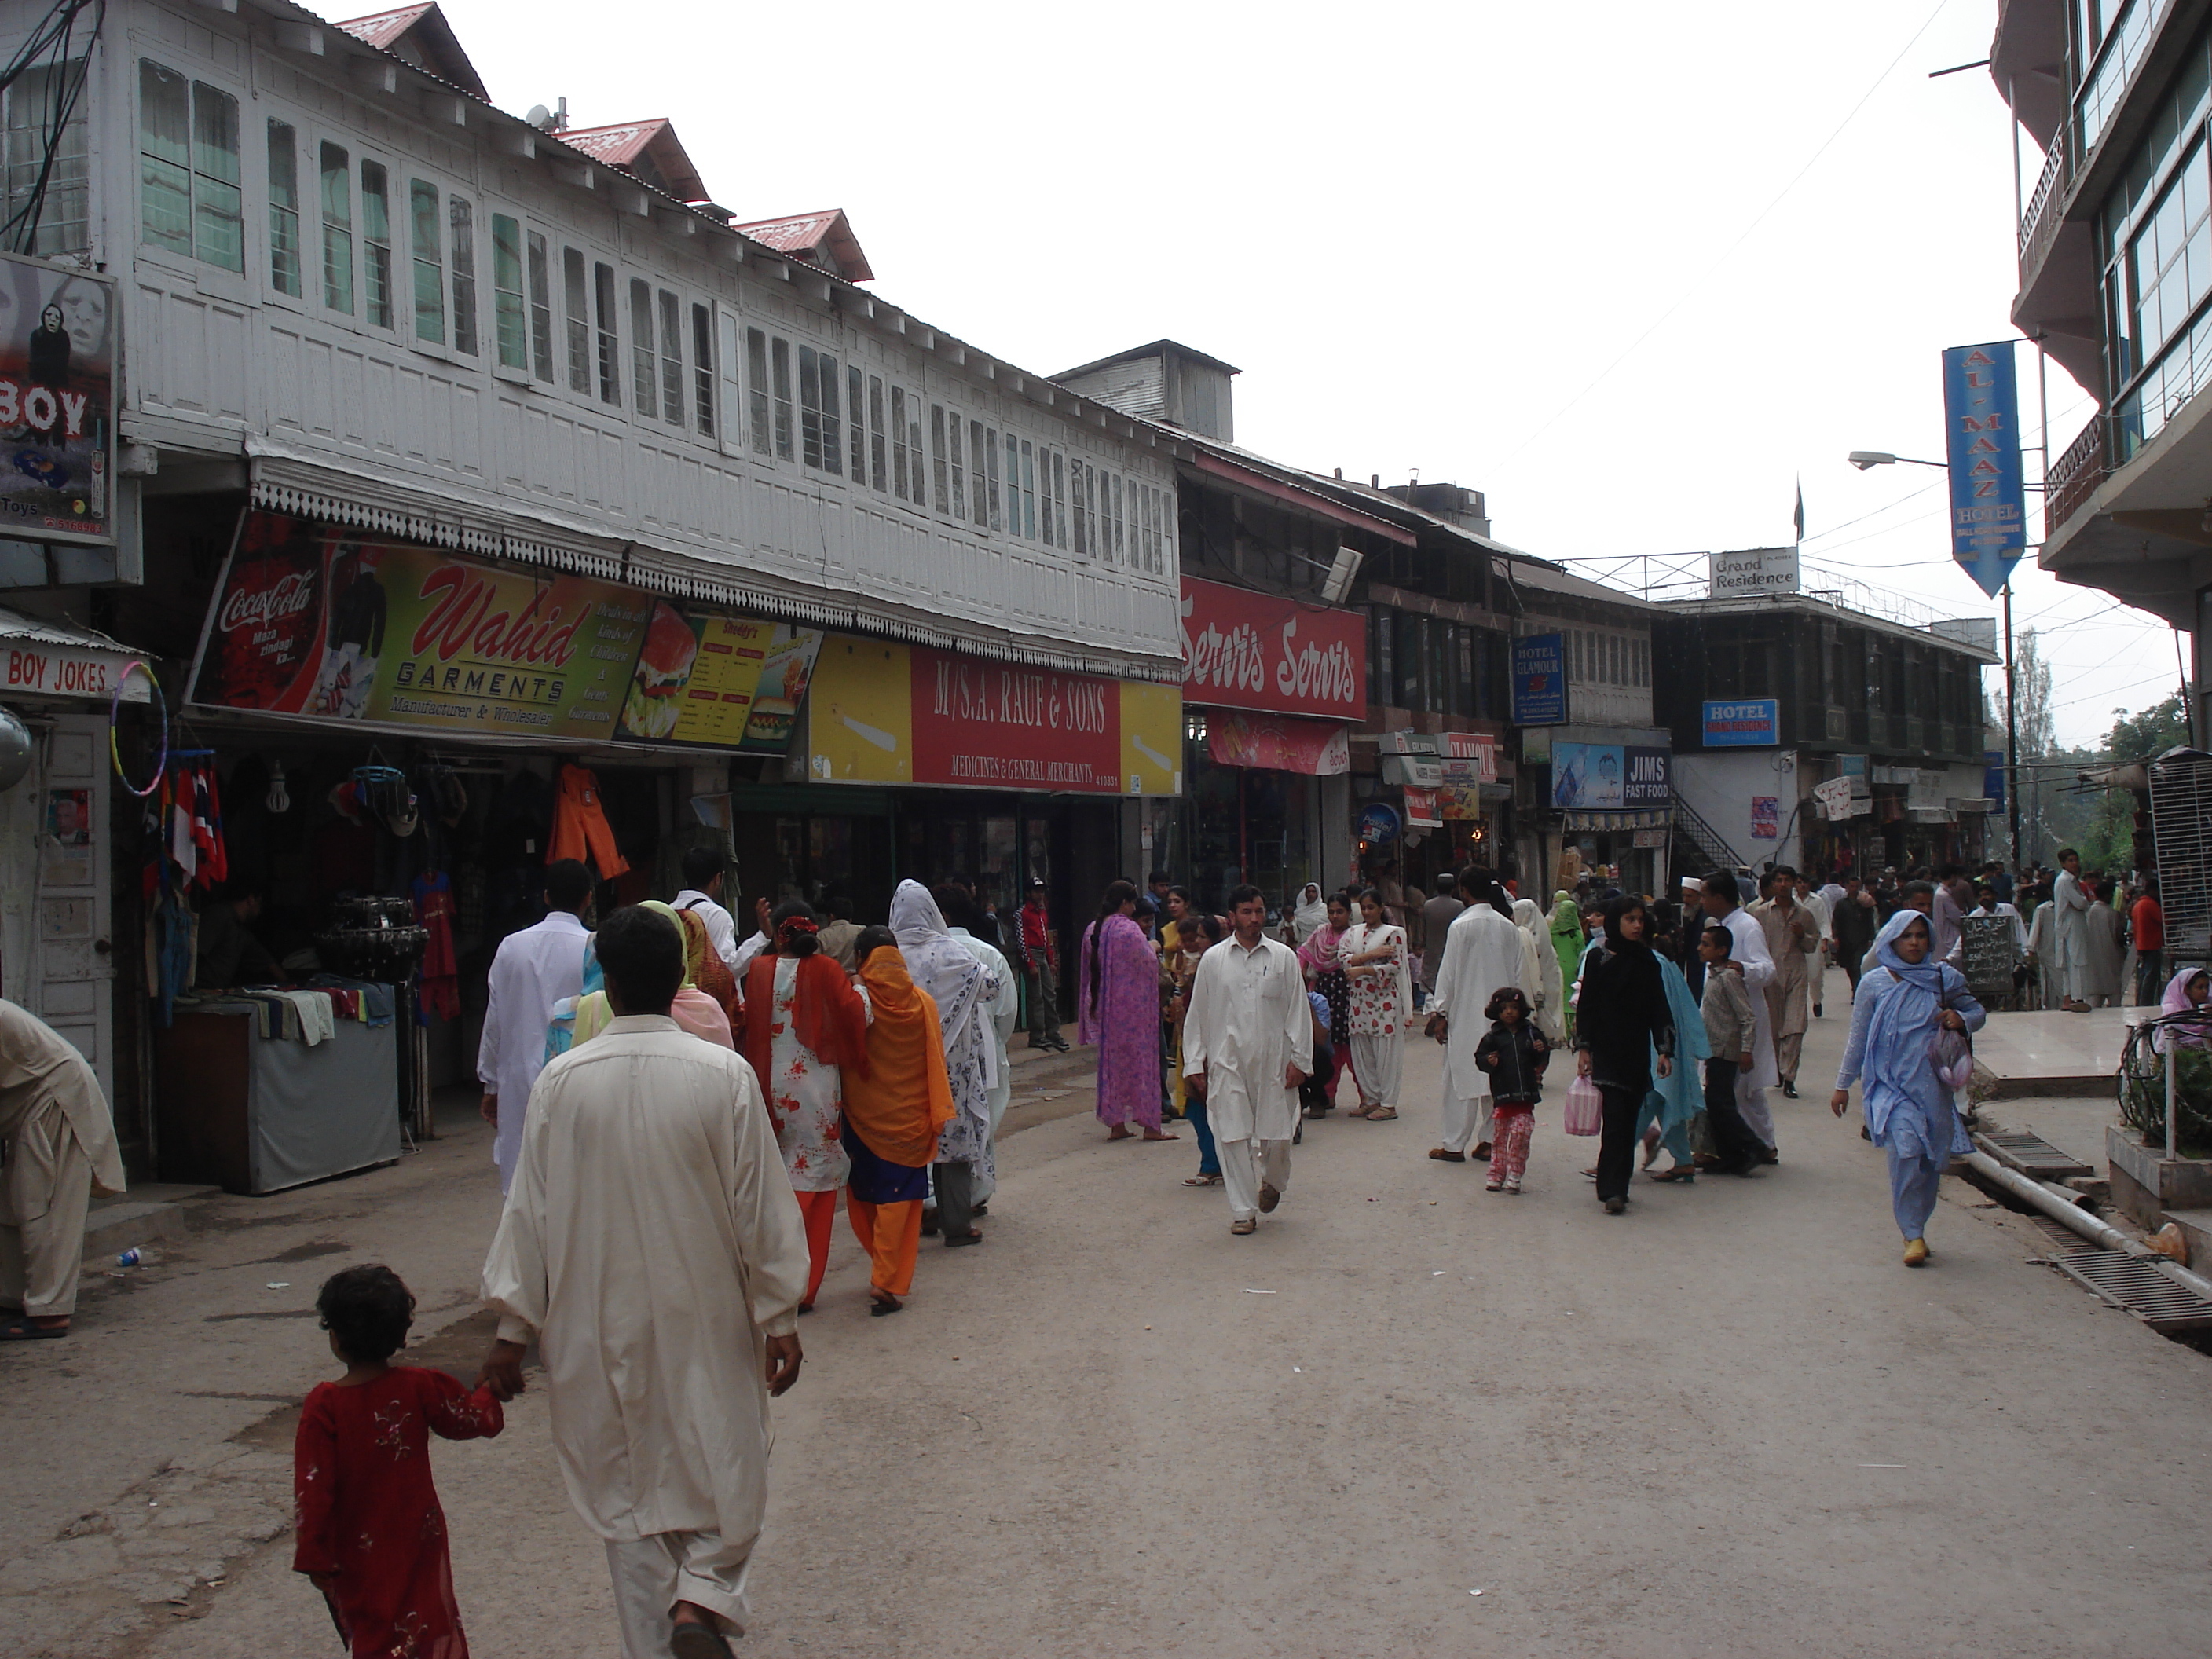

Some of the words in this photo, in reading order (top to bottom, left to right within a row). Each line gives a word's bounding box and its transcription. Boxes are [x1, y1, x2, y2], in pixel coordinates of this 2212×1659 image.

[0, 380, 87, 436] BOY
[2, 497, 38, 516] Toys
[1957, 504, 2020, 524] HOTEL
[1716, 558, 1762, 573] Grand
[1716, 573, 1794, 588] Residence
[412, 565, 591, 670] Wahid
[595, 602, 621, 619] Deals
[252, 629, 277, 645] Maza
[597, 624, 621, 641] kinds
[623, 628, 637, 646] of
[260, 635, 294, 657] zindagi
[591, 644, 629, 663] Children
[1518, 646, 1556, 659] HOTEL
[1277, 616, 1355, 704] Servis
[1517, 659, 1559, 675] GLAMOUR
[8, 650, 48, 689] BOY
[54, 659, 106, 693] JOKES
[598, 668, 607, 681] &
[396, 661, 568, 703] GARMENTS
[584, 687, 609, 702] Gents
[999, 670, 1044, 727] RAUF
[1049, 677, 1061, 729] &
[1066, 681, 1105, 735] SONS
[390, 696, 472, 720] Manufacturer
[476, 705, 488, 720] &
[494, 706, 554, 727] Wholesaler
[569, 705, 610, 723] Garments
[1710, 705, 1767, 720] HOTEL
[951, 755, 1000, 779] MEDICINES
[1000, 757, 1009, 779] &
[1008, 759, 1046, 782] GENERAL
[1046, 761, 1093, 784] MERCHANTS
[1095, 775, 1119, 787] 410331
[1630, 756, 1664, 782] JIMS
[1626, 784, 1646, 799] FAST
[1647, 783, 1669, 799] FOOD
[1363, 815, 1393, 833] Paktel
